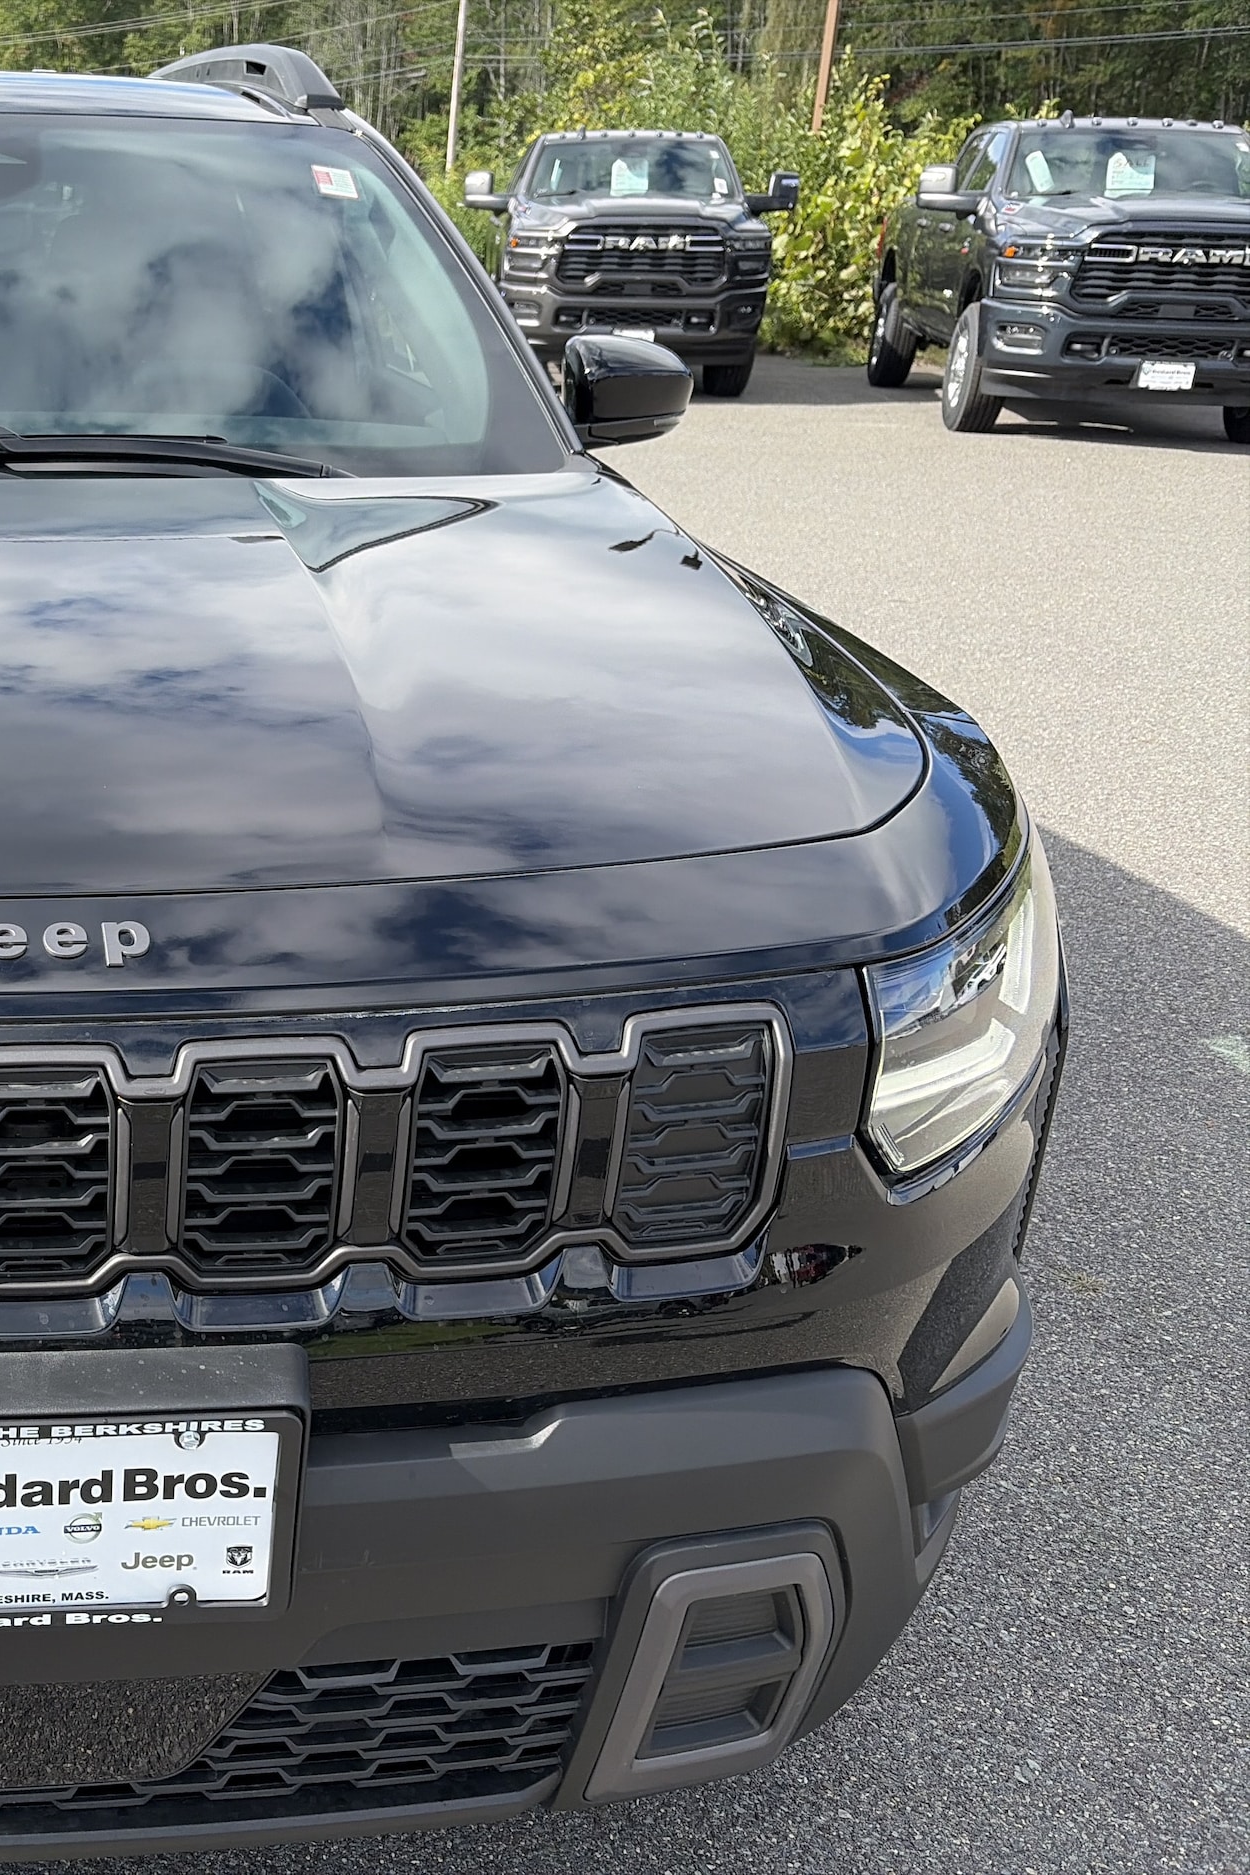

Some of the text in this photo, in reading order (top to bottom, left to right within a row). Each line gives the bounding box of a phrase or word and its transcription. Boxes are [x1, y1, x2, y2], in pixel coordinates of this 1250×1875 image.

[604, 236, 686, 251] RAM
[1137, 247, 1245, 264] RAM
[51, 1419, 265, 1437] BERKSHIRES
[122, 1468, 267, 1502] Bros.
[181, 1516, 261, 1527] CHEVROLET
[121, 1552, 194, 1571] Jeep
[61, 1591, 109, 1602] MASS.
[66, 1613, 162, 1625] Bros.
